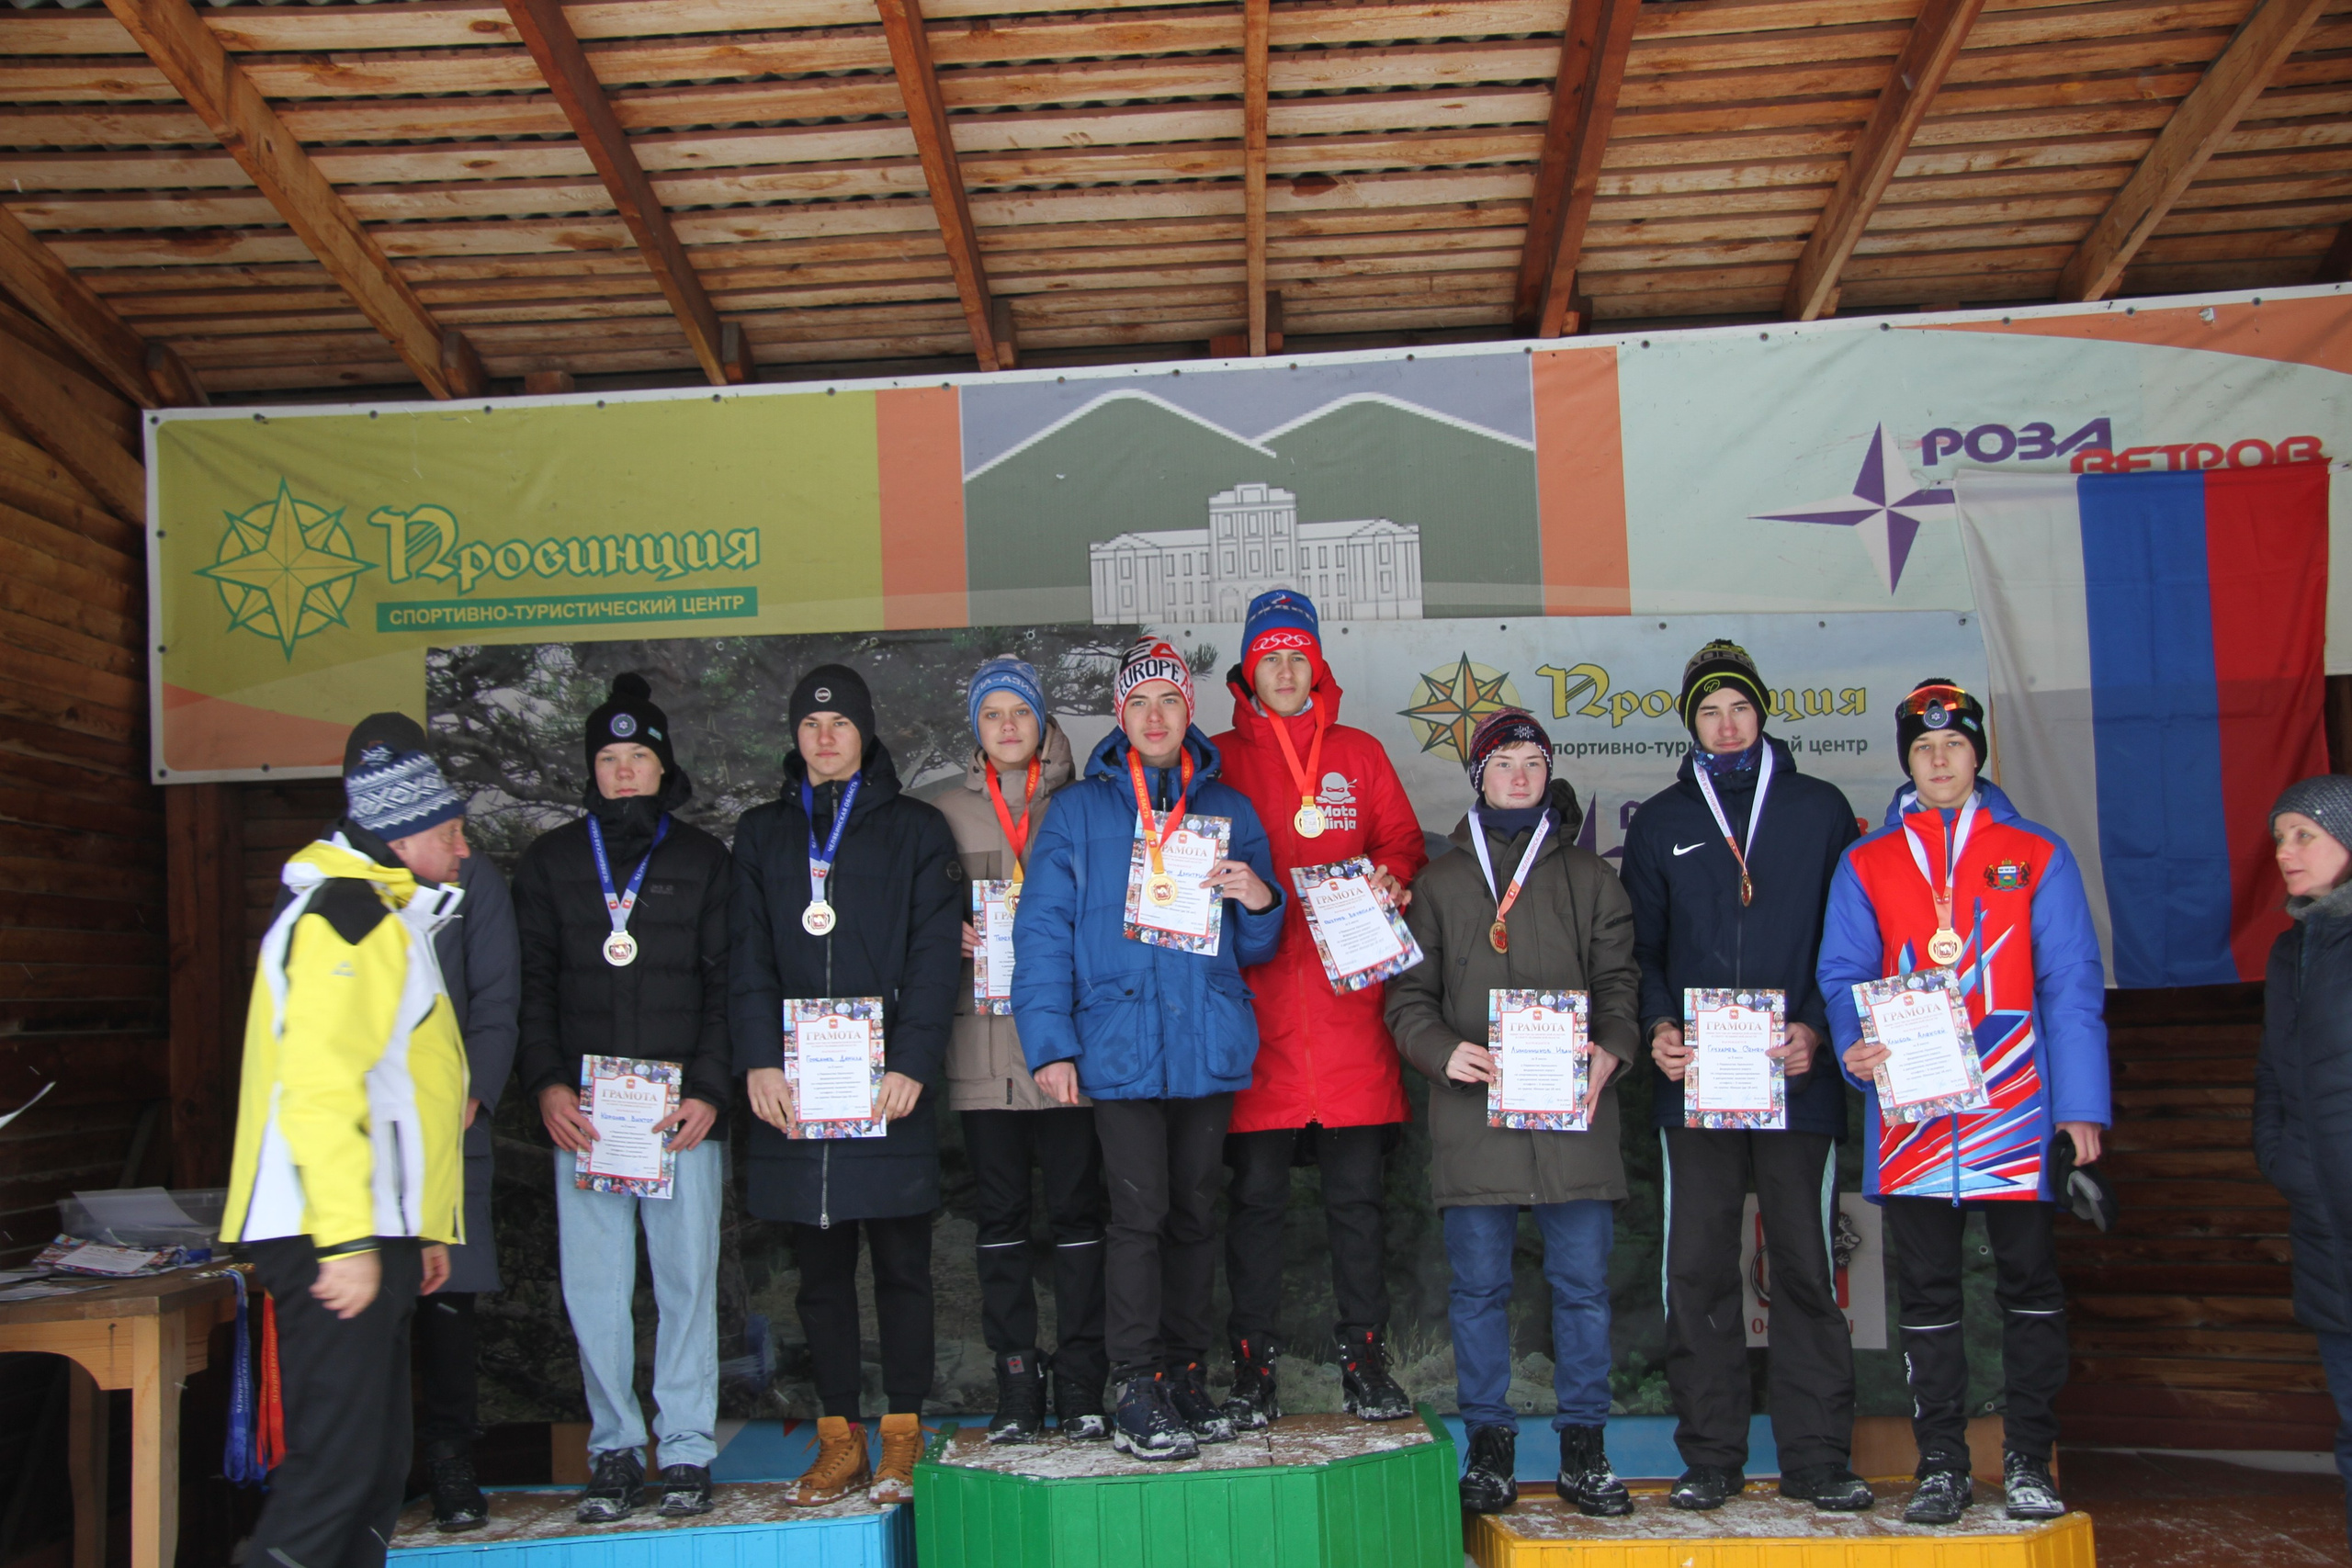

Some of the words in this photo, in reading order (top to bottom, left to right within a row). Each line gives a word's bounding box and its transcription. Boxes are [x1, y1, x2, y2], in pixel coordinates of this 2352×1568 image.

[1922, 417, 2112, 467] РОЗА
[2070, 435, 2324, 474] ВЕТРОВ
[368, 503, 761, 597] Провинция
[390, 595, 677, 626] СПОРТИВНО-ТУРИСТИЧЕСКИЙ
[682, 594, 746, 618] ЦЕНТР
[1118, 659, 1180, 697] EUROPE
[1535, 662, 1866, 729] Проция
[1808, 738, 1869, 756] центр
[1137, 786, 1149, 819] ОБЛАСТЬ
[1317, 805, 1357, 818] Moto
[827, 806, 848, 853] ЧЕЛЯБИНСКАЯ
[844, 780, 859, 807] ОБЛАСТЬ
[1324, 818, 1357, 831] inja
[1160, 844, 1208, 857] РАМОТА
[1521, 827, 1544, 873] ЧЕЛЯБИНСКАЯ
[1316, 887, 1364, 905] ГРАМОТА
[1883, 1003, 1941, 1023] ГРАМОТА
[806, 1030, 862, 1041] ГРАМОТА
[1510, 1022, 1566, 1032] ГРАМОТА
[1706, 1021, 1762, 1032] ГРАМОТА
[602, 1089, 659, 1102] ГРАМОТА
